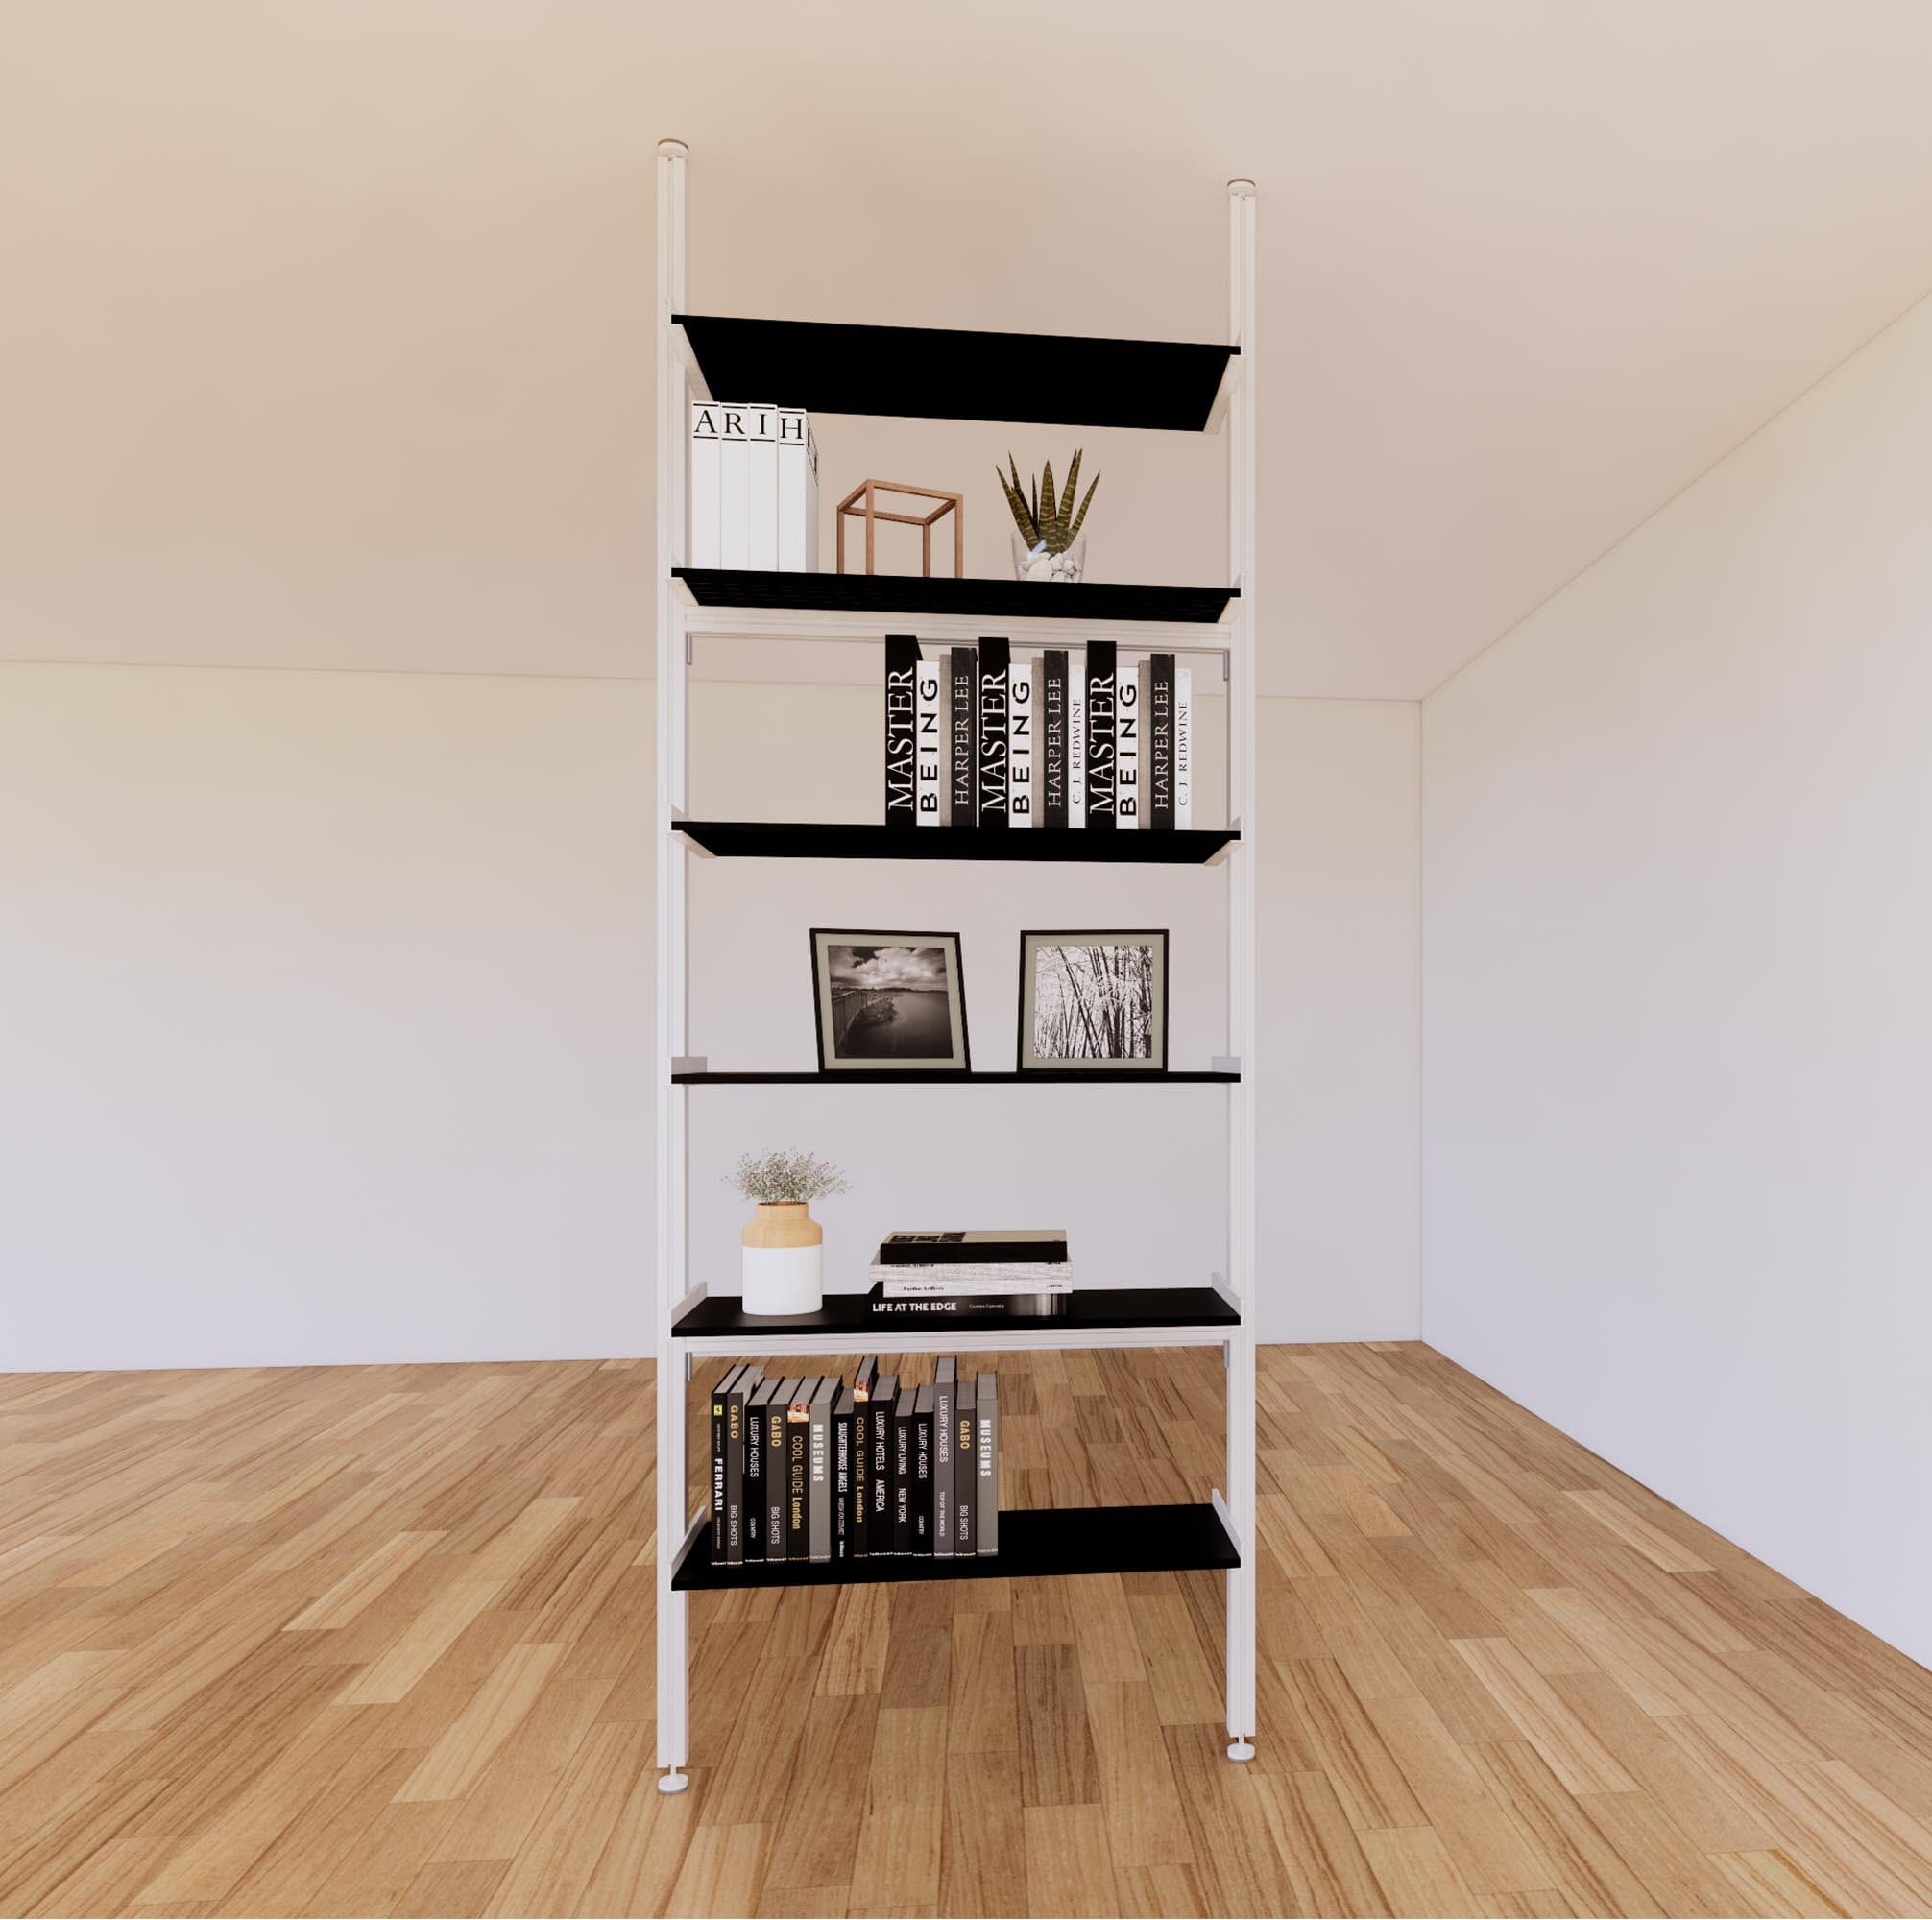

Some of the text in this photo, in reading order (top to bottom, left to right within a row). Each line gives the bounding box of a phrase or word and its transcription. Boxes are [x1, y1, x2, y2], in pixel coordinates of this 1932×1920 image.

[887, 667, 913, 811] MASTER
[921, 679, 937, 812] BEING
[955, 676, 968, 805] HARPER LEE
[981, 669, 1006, 812] MASTER
[1013, 682, 1029, 813] BEING
[1049, 678, 1061, 806] HARPER LEE
[1073, 698, 1081, 769] REDWINE
[1089, 673, 1114, 814] MASTER
[1120, 684, 1136, 815] BEING
[1155, 681, 1168, 809] HARPER LEE
[873, 1302, 956, 1312] LIFE AT THE EDGE
[750, 1417, 759, 1477] LUXURY HOUSES
[771, 1416, 781, 1448] GABO
[813, 1424, 824, 1482] MUSEUMS
[838, 1422, 848, 1471] SLAUGHTERHOUSE
[876, 1411, 885, 1471] LUXURY HOTELS
[939, 1396, 949, 1463] LUXURY HOUSES
[960, 1420, 970, 1450] GABO
[980, 1419, 991, 1476] MUSEUMS
[792, 1436, 803, 1530] COOL GUIDE London
[838, 1473, 848, 1493] ANGELS
[876, 1479, 885, 1512] AMERICA
[771, 1506, 780, 1545] BIG SHOTS
